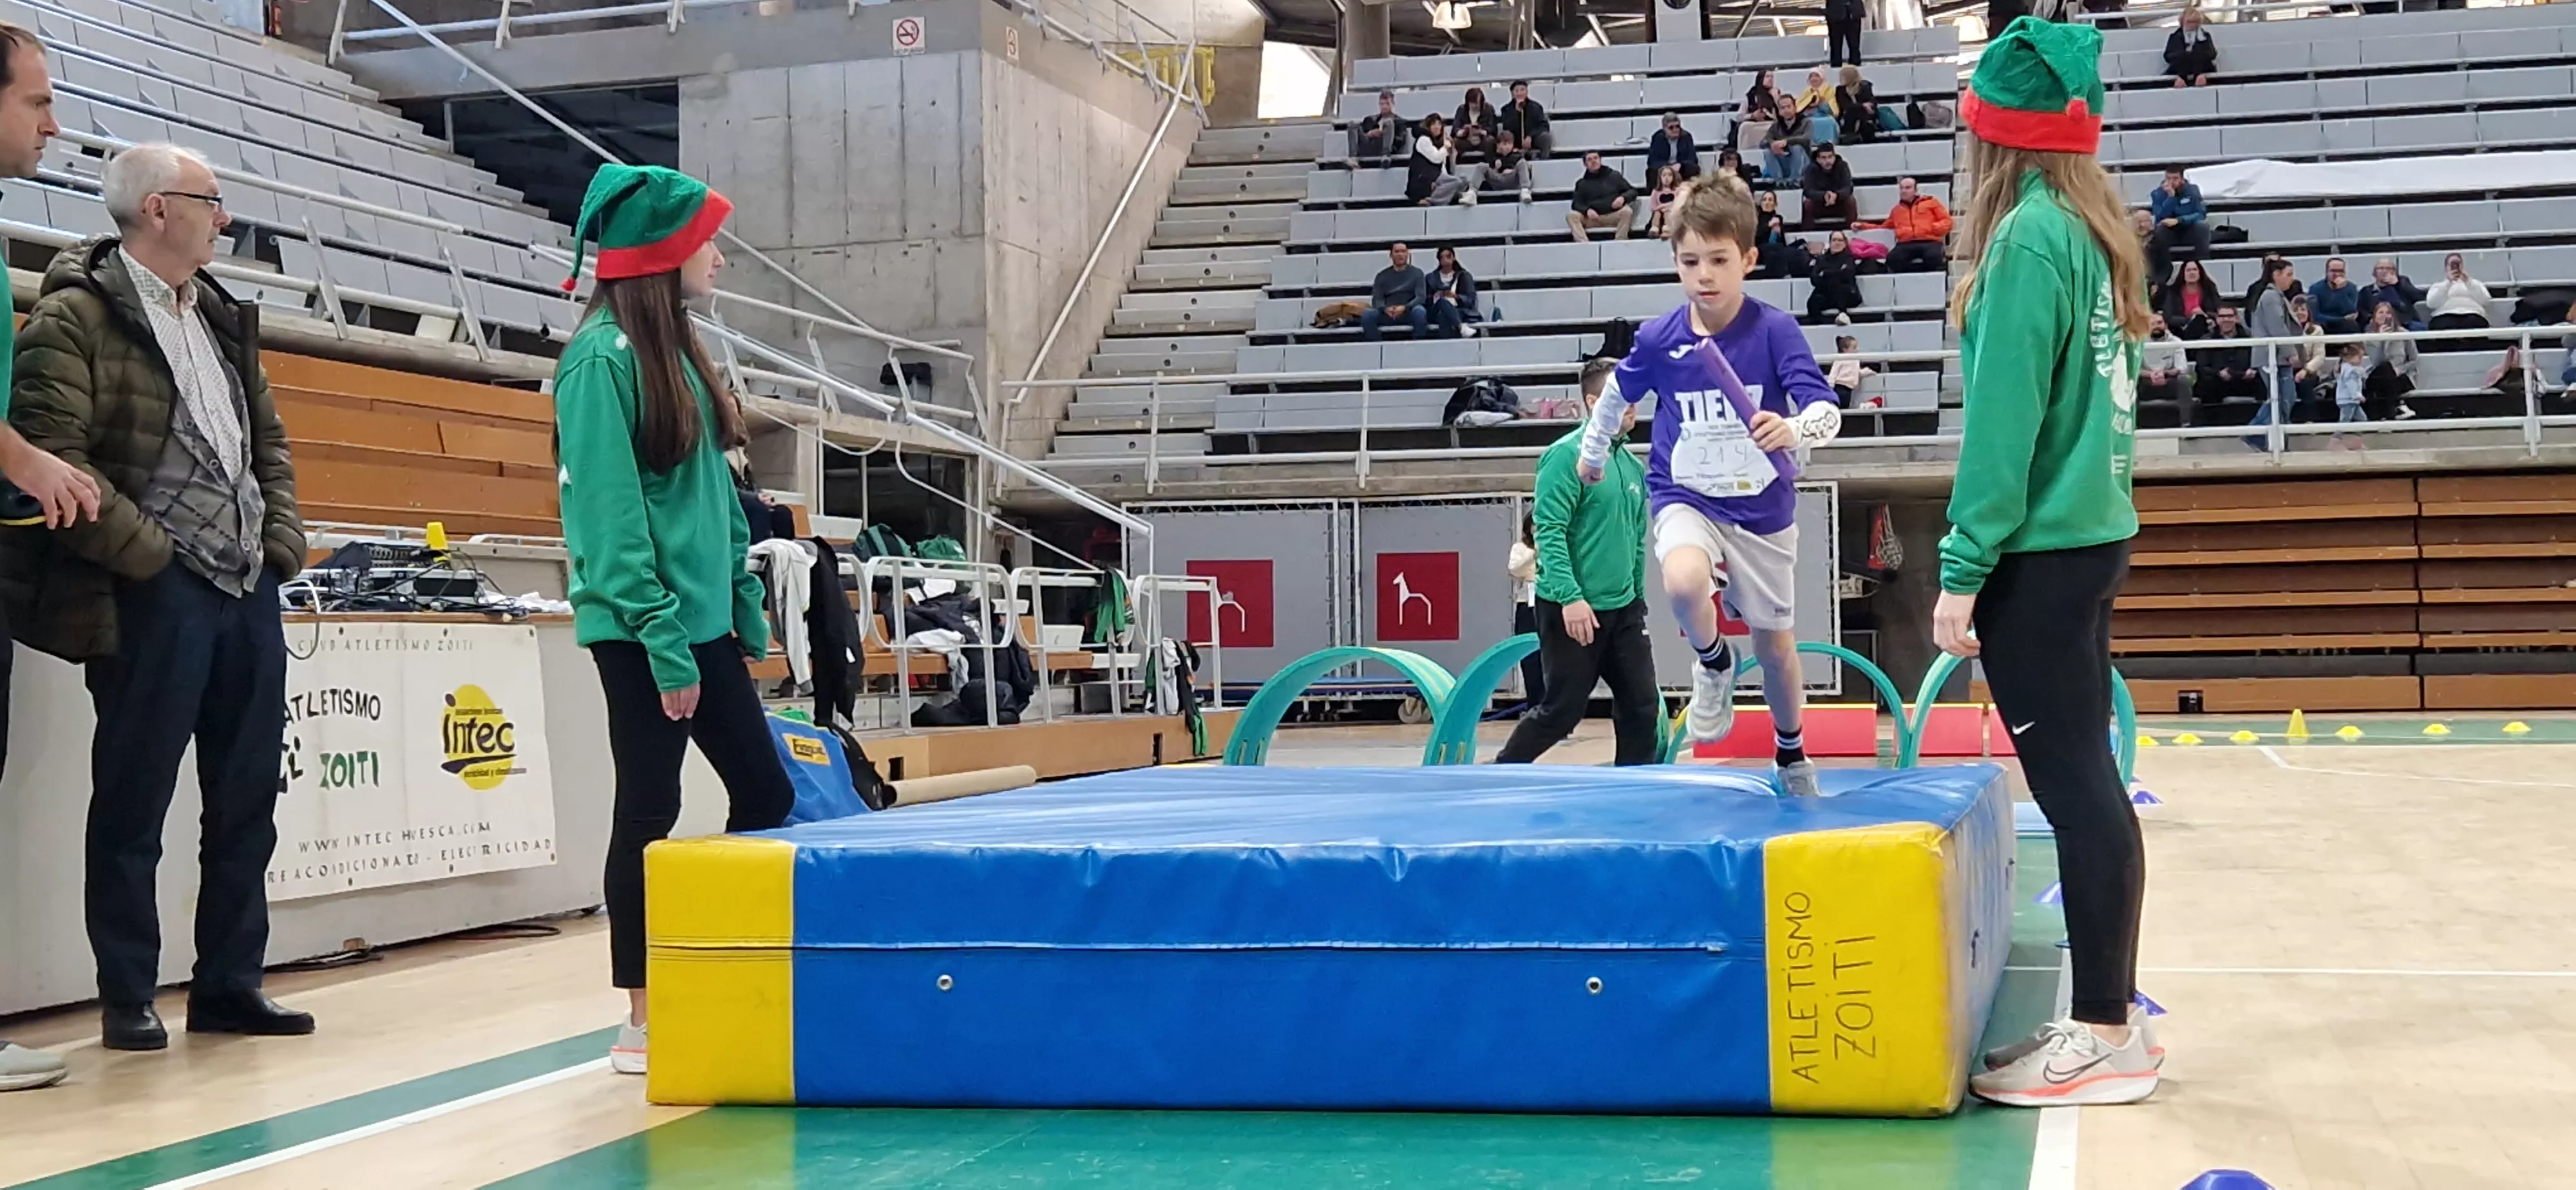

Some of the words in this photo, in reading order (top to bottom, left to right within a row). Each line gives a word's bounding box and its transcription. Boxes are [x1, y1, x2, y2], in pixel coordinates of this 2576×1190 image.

[345, 639, 430, 651] ATLETISMO
[438, 639, 473, 651] ZOITI
[319, 750, 379, 790] ZOITI
